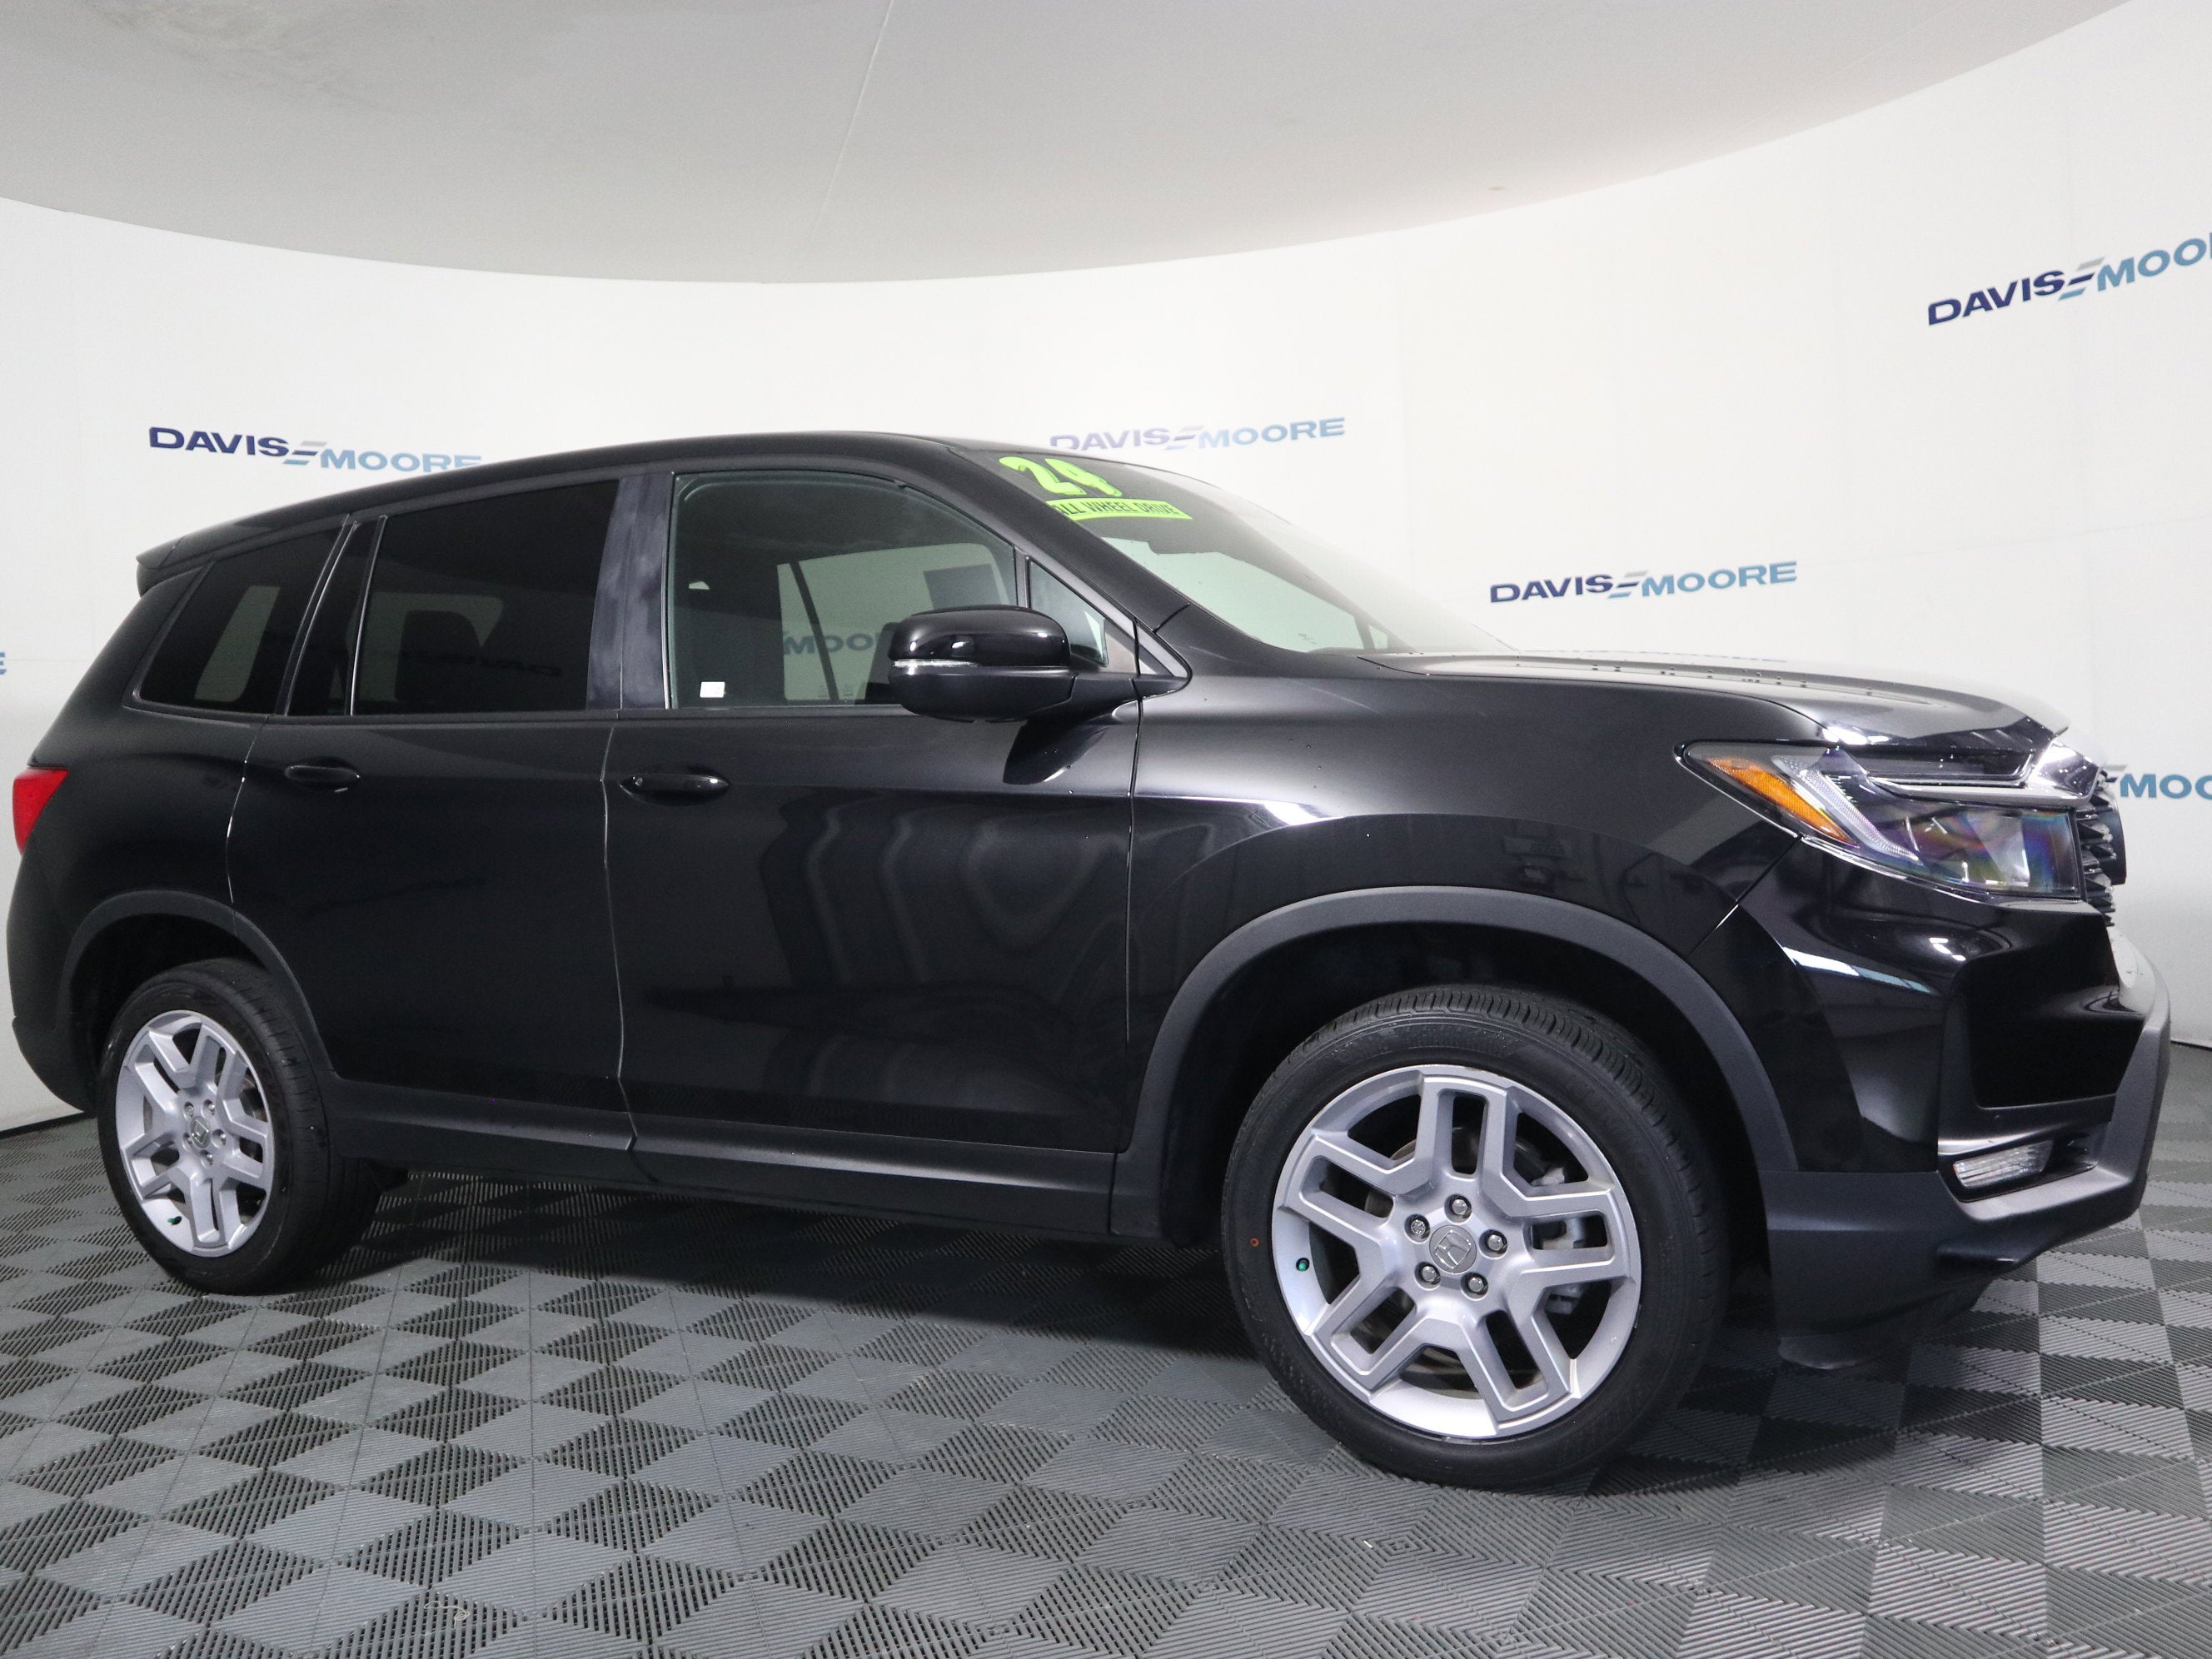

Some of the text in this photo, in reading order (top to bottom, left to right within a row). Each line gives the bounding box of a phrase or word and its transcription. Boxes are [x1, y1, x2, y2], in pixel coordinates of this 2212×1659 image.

[1928, 232, 2212, 325] DAVIS MOO
[148, 426, 289, 457] DAVIS
[1049, 416, 1345, 451] DAVIS MOORE
[999, 456, 1123, 497] 24
[1080, 501, 1138, 512] WHEEL
[1133, 502, 1180, 515] DRIVE
[1490, 560, 1797, 604] DAVIS MOORE
[784, 633, 879, 655] MOO
